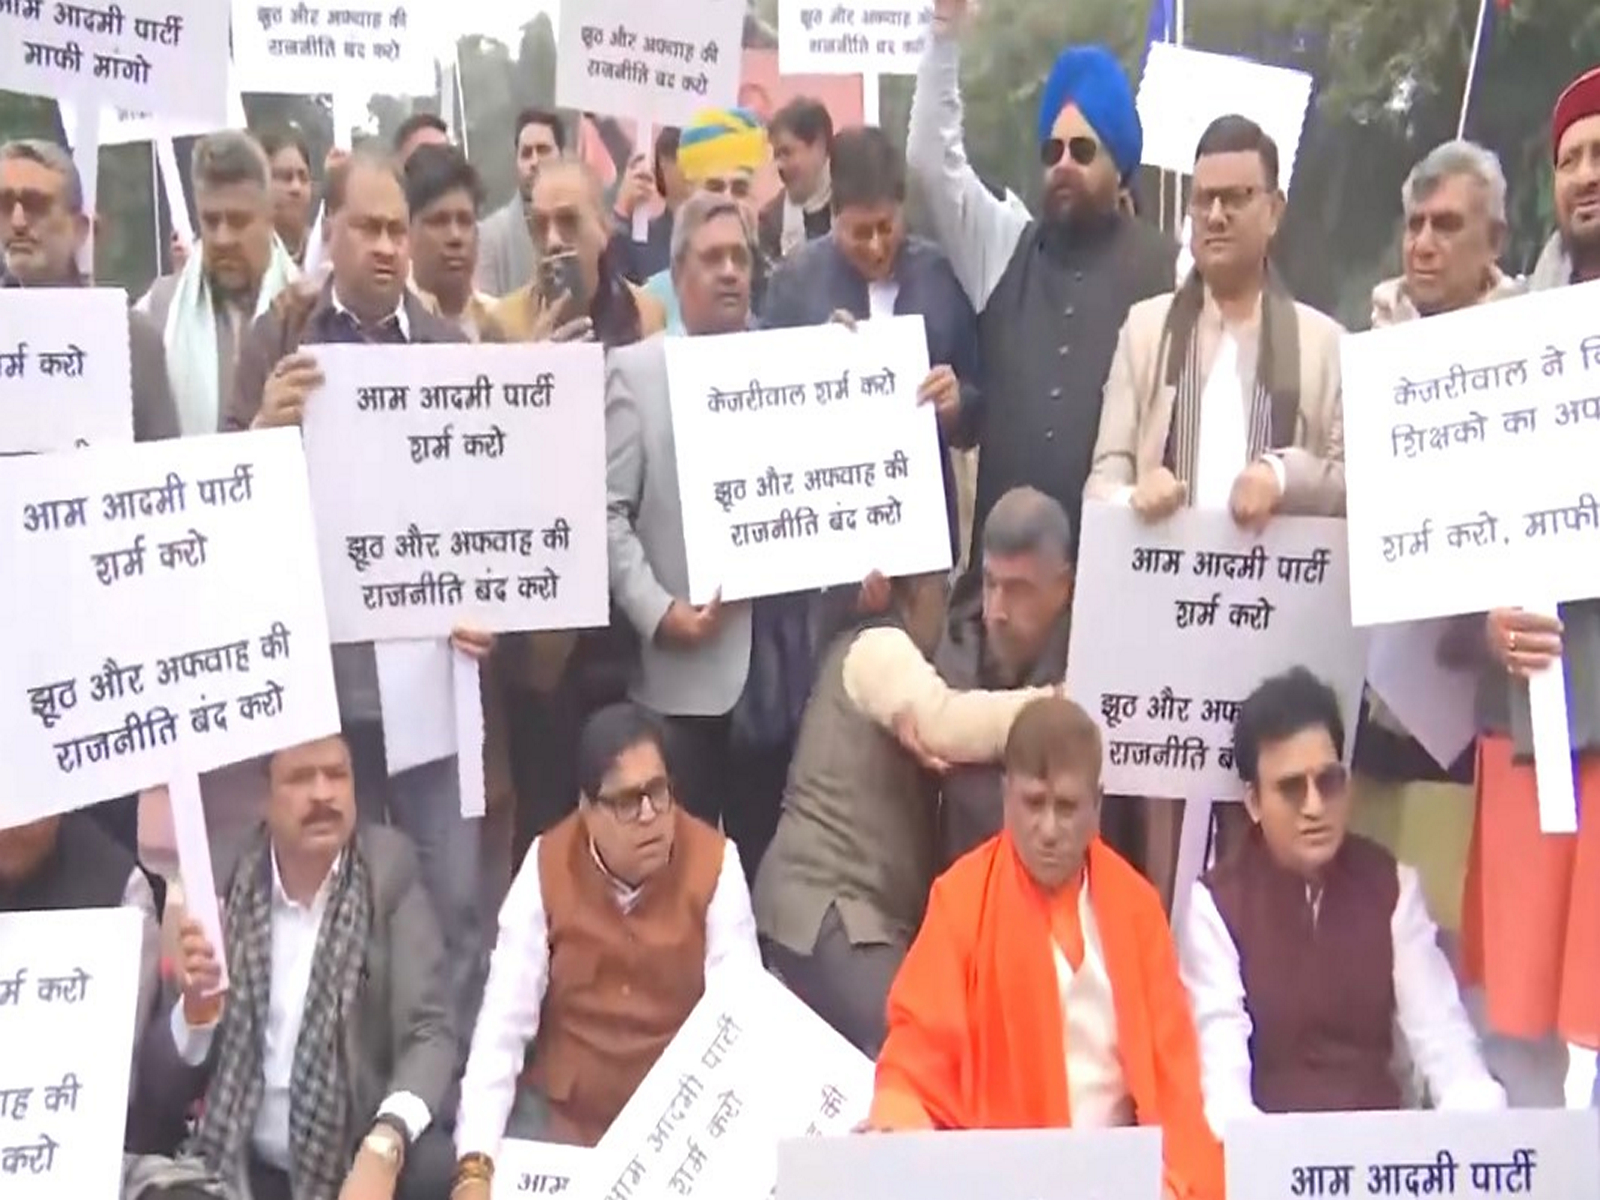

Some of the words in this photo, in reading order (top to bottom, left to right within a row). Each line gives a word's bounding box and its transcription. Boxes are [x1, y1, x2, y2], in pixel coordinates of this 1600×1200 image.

[53, 2, 125, 35] आदमी
[134, 15, 183, 46] पार्टी
[23, 41, 83, 72] माफी
[38, 343, 87, 377] करो
[1393, 364, 1529, 407] केजरीवाल
[1540, 344, 1567, 377] ने
[357, 385, 410, 411] आम
[420, 374, 493, 410] आदमी
[503, 373, 555, 408] पार्टी
[707, 379, 806, 414] केजरीवाल
[814, 370, 850, 406] शर्म
[860, 367, 897, 397] करो
[1502, 407, 1538, 434] का
[1554, 396, 1600, 426] अप
[407, 424, 454, 464] शर्म
[462, 425, 507, 459] करो
[23, 497, 88, 531] आम
[102, 472, 187, 521] आदमी
[197, 463, 254, 508] पार्टी
[713, 479, 747, 514] झूठ
[756, 465, 795, 499] और
[804, 462, 876, 493] अफवाह
[884, 449, 910, 480] की
[730, 506, 820, 548] राजनीति
[829, 501, 858, 532] बंद
[866, 495, 903, 526] करो
[1381, 518, 1434, 564] शर्म
[91, 535, 146, 586] शर्म
[158, 528, 208, 571] करो
[346, 535, 384, 572] झूठ
[395, 522, 440, 558] और
[450, 529, 533, 556] अफवाह
[542, 517, 571, 552] की
[1131, 547, 1185, 576] आम
[1192, 545, 1269, 581] आदमी
[1277, 548, 1332, 584] पार्टी
[361, 571, 465, 611] राजनीति
[475, 567, 508, 602] बंद
[518, 567, 561, 600] करो
[1175, 592, 1222, 630] शर्म
[1229, 597, 1276, 630] करो
[27, 679, 77, 729] झूठ
[90, 657, 143, 701] और
[156, 639, 250, 685] अफवाह
[259, 621, 291, 660] की
[53, 705, 179, 774] राजनीति
[190, 693, 227, 733] बंद
[238, 680, 284, 721] करो
[1101, 692, 1138, 729] झूठ
[1146, 685, 1192, 723] और
[1109, 734, 1209, 770] राजनीति
[1218, 738, 1235, 770] बं
[0, 967, 28, 1005] र्म
[37, 967, 93, 1004] करो
[45, 1072, 82, 1112] की
[2, 1133, 60, 1174] करो
[1290, 1164, 1354, 1197] आम
[1367, 1149, 1458, 1198] आदमी
[1470, 1148, 1537, 1194] पार्टी
